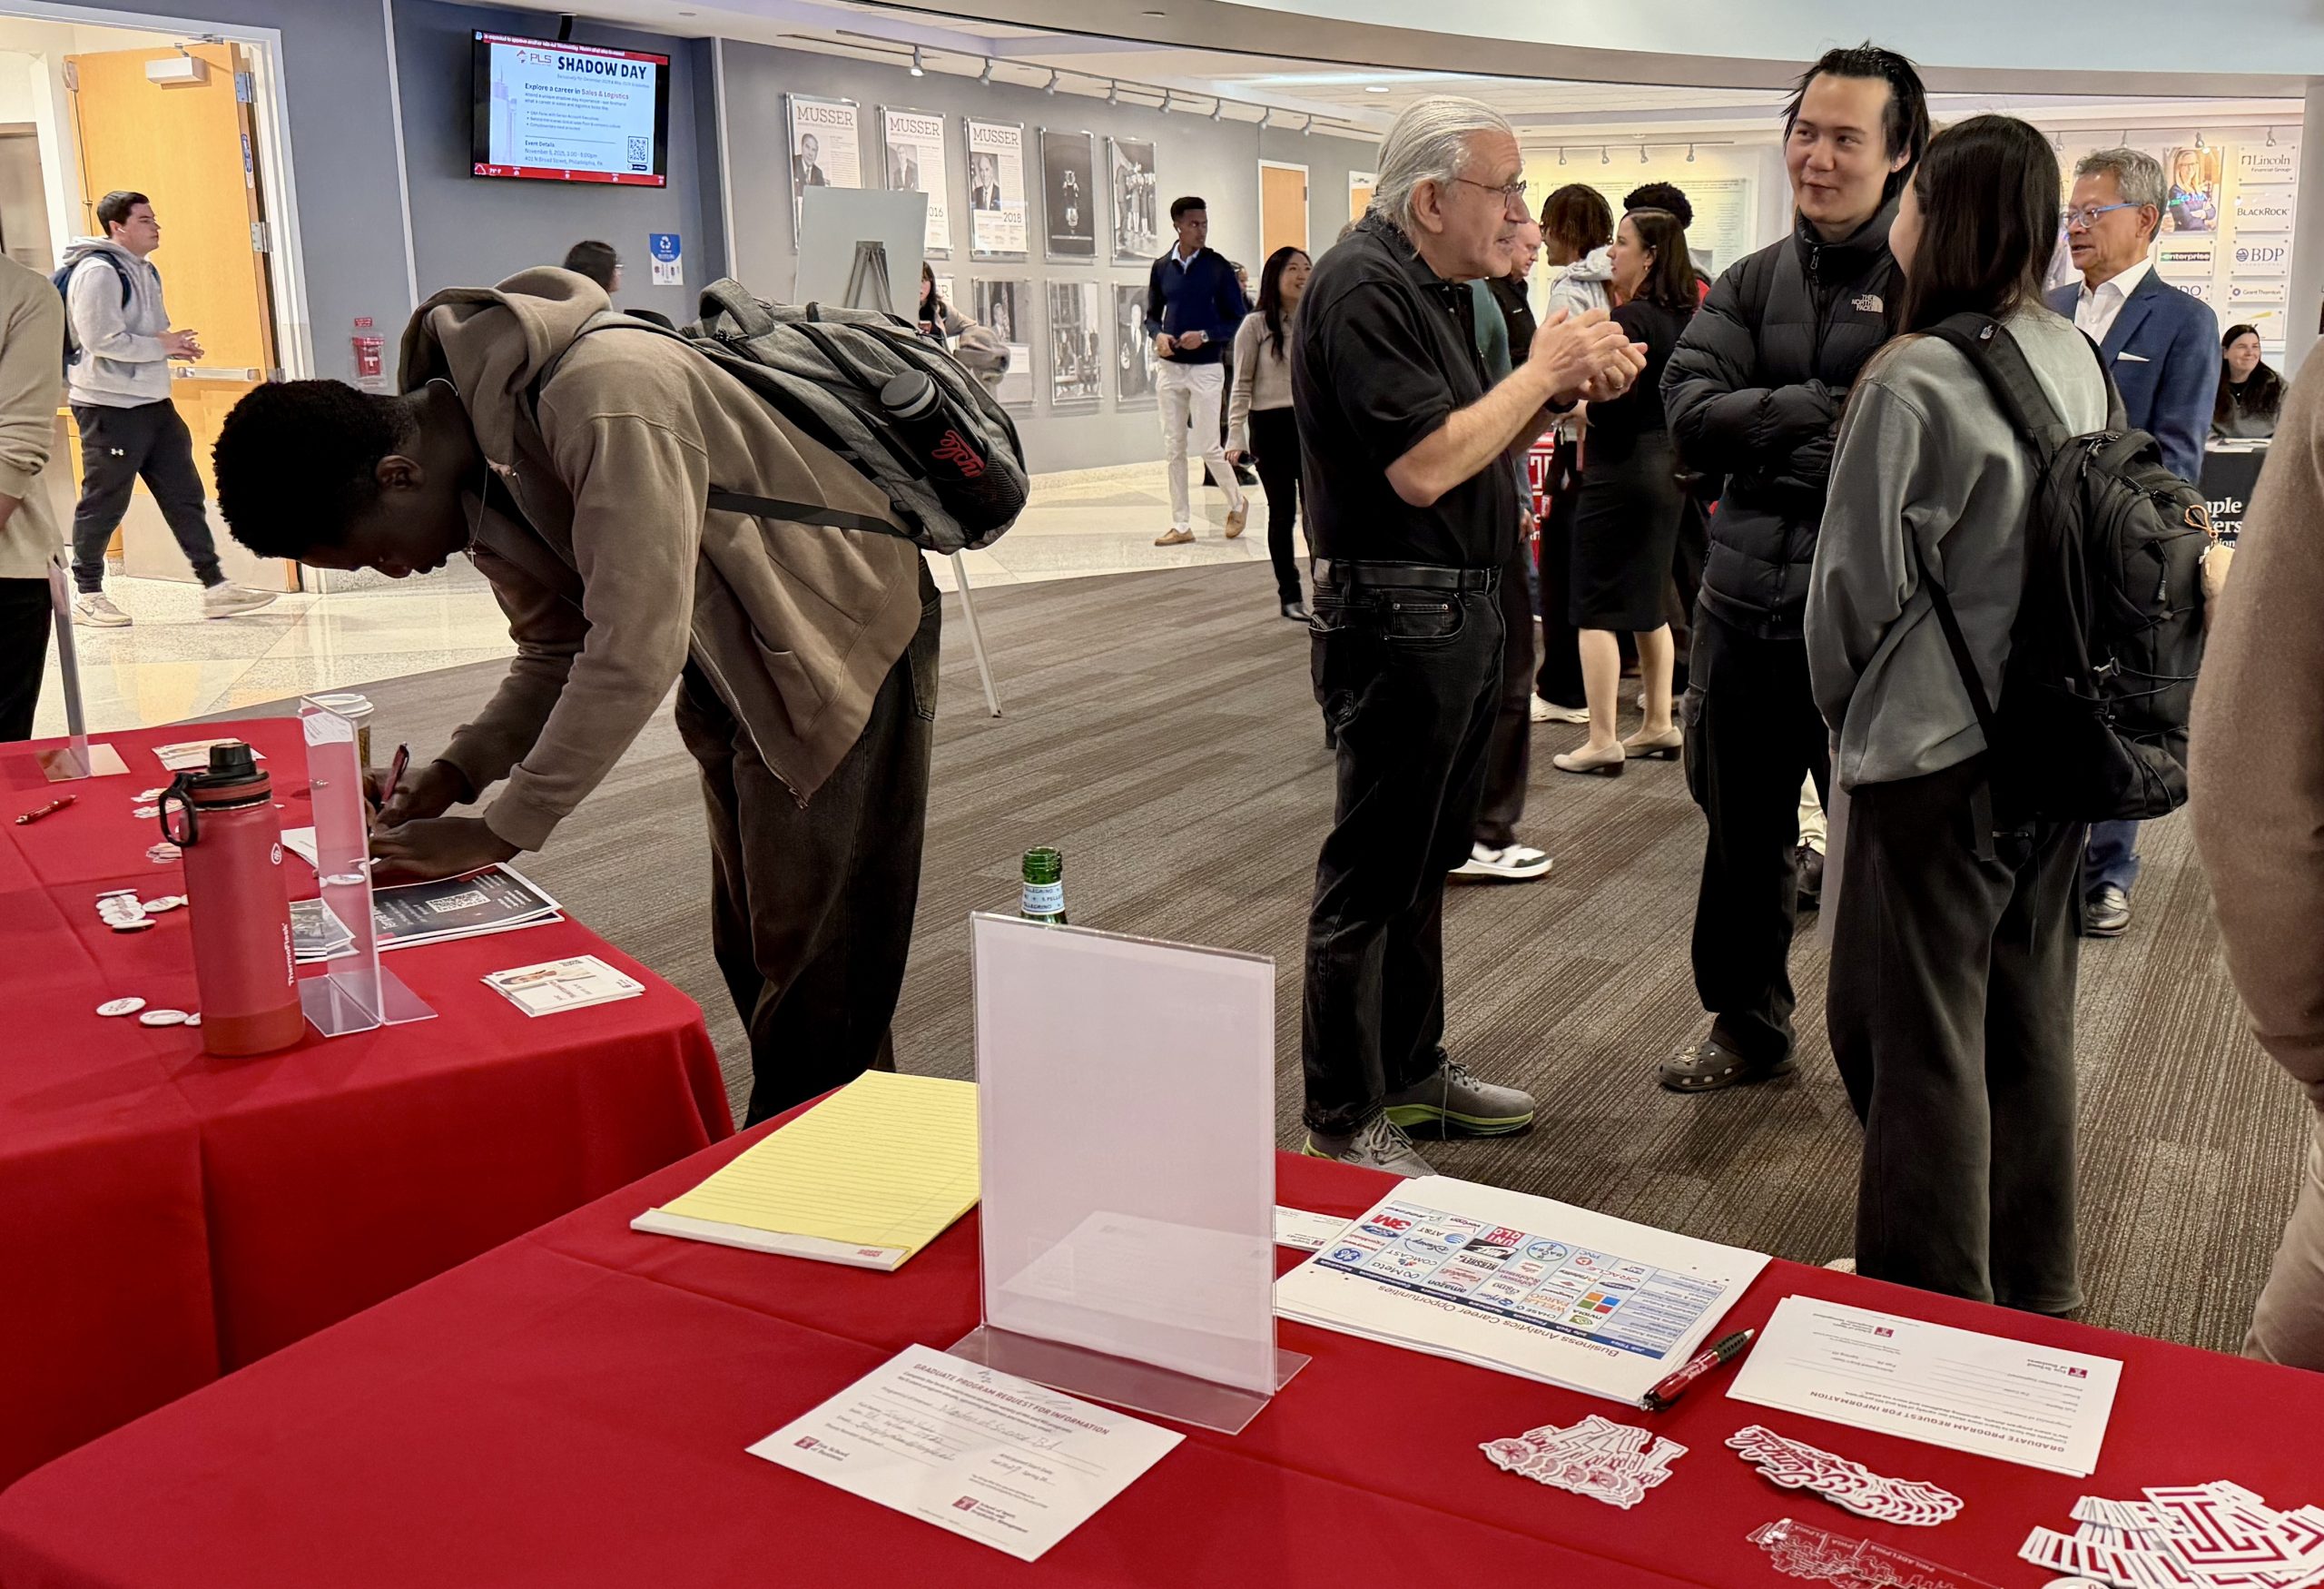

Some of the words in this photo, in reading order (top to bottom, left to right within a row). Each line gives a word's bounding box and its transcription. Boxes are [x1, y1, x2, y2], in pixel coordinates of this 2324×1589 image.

[530, 54, 551, 64] PLS
[558, 56, 617, 76] SHADOW
[622, 64, 646, 79] DAY
[526, 83, 547, 92] Explore
[797, 105, 853, 126] MUSSER
[891, 117, 940, 136] MUSSER
[974, 128, 1019, 145] MUSSER
[2253, 154, 2290, 165] Lincoln
[929, 207, 943, 217] 016
[1004, 212, 1021, 223] 2018
[2162, 253, 2210, 262] enterprise
[2251, 248, 2284, 262] BDP
[2180, 285, 2201, 296] DO
[283, 923, 294, 986] ThermoFlask
[1371, 1214, 1412, 1230] 3M
[1450, 1218, 1481, 1228] verizon
[1417, 1227, 1445, 1237] AT&T
[1386, 1249, 1437, 1266] COMCAST
[1579, 1250, 1600, 1259] PNC
[1372, 1262, 1403, 1275] Meta
[1586, 1266, 1640, 1283] ORACLE
[1427, 1280, 1466, 1293] amazon
[1499, 1275, 1533, 1288] Johnson
[1378, 1286, 1456, 1313] Opportunities
[1524, 1298, 1565, 1313] WELLS
[1531, 1293, 1570, 1308] FARGO
[1458, 1308, 1501, 1325] Career
[1525, 1308, 1556, 1318] CHASE
[1572, 1308, 1602, 1320] NVIDIA
[1503, 1320, 1559, 1340] Analytics
[1561, 1336, 1619, 1357] Business
[913, 1363, 958, 1383] GRADUATE
[958, 1377, 996, 1397] PROGRAM
[996, 1391, 1034, 1409] REQUEST
[1034, 1405, 1051, 1416] FOR
[1050, 1410, 1110, 1436] INFORMATION
[1810, 1391, 1880, 1412] INFORMATION
[1904, 1413, 1951, 1426] REQUEST
[1953, 1424, 2005, 1439] PROGRAM
[2008, 1436, 2064, 1453] GRADUATE
